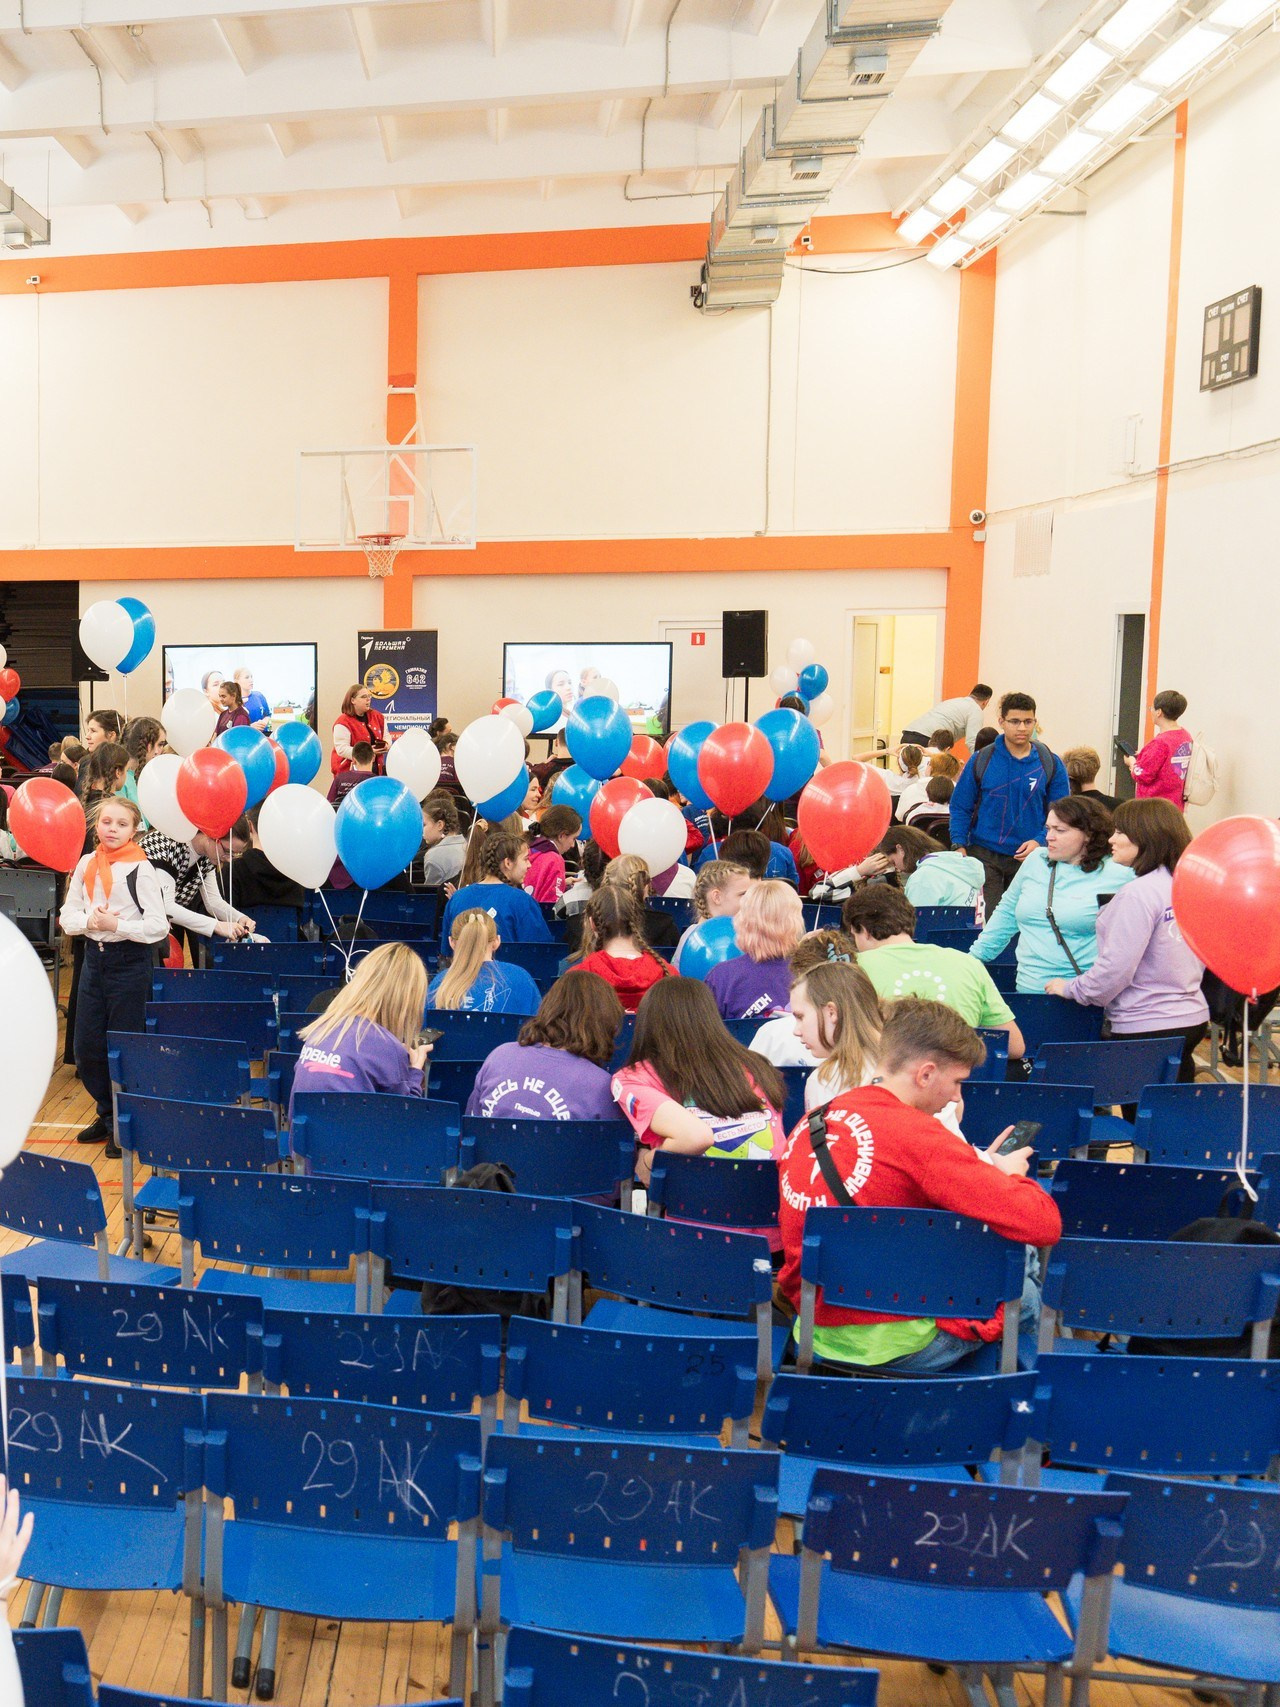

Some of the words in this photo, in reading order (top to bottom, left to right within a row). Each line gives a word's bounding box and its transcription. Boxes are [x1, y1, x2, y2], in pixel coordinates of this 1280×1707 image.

[406, 674, 426, 685] 642
[514, 1102, 541, 1118] Первые
[523, 1076, 546, 1095] НЕ
[543, 1087, 571, 1121] ОЦЕ
[716, 1130, 738, 1140] ЕСТЬ
[112, 1308, 163, 1342] 29
[7, 1407, 62, 1453] 29
[301, 1430, 358, 1499] 29
[573, 1470, 654, 1526] 29
[914, 1510, 969, 1546] 29
